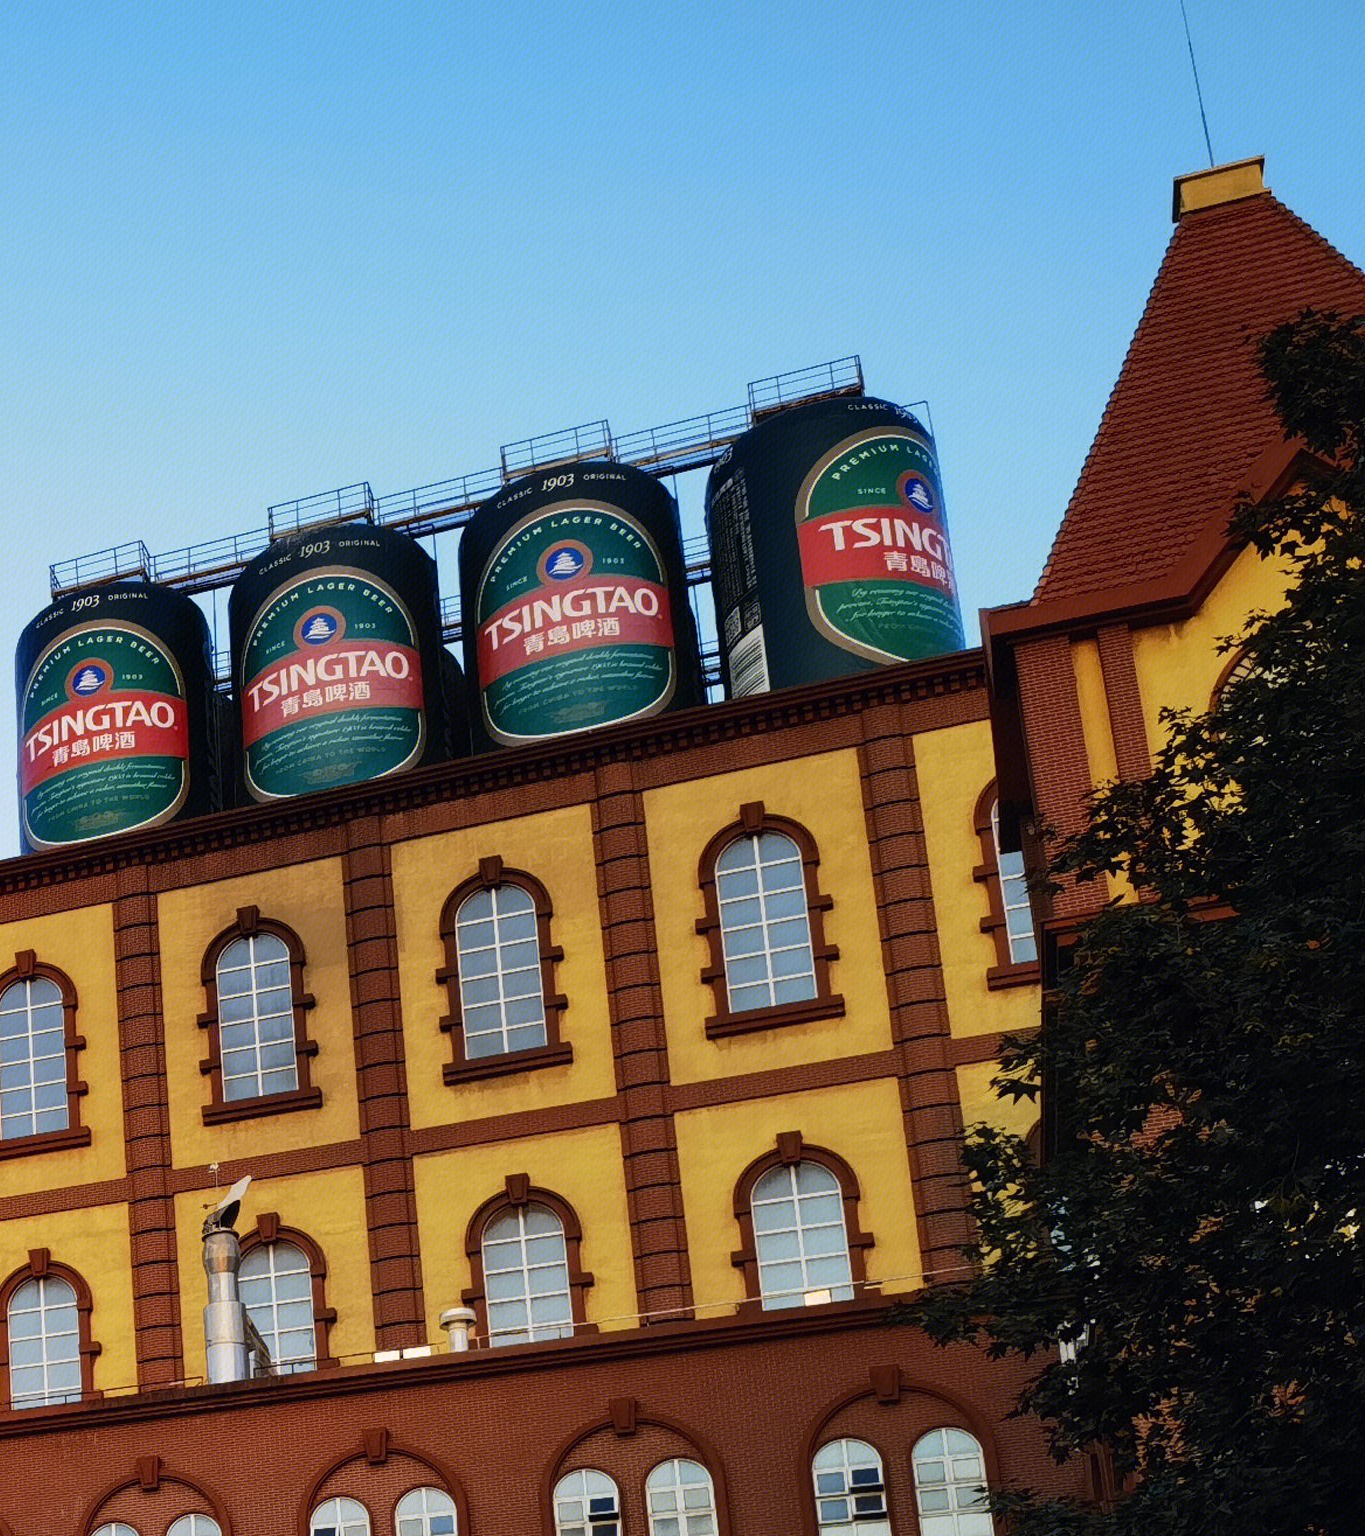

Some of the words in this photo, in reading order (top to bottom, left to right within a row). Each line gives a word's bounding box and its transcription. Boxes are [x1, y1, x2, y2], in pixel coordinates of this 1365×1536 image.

[847, 403, 889, 411] CLASSIC
[832, 444, 900, 480] PREMIUM
[496, 487, 533, 510] CLASSIC
[541, 473, 574, 492] 1903
[857, 487, 887, 495] SINCE
[258, 554, 292, 576] CLASSIC
[299, 540, 331, 559] 1903
[338, 539, 381, 548] ORIGINAL
[490, 526, 543, 583] PREMIUM
[551, 516, 603, 528] LAGER
[609, 523, 642, 549] BEER
[36, 608, 65, 629] CLASSIC
[71, 594, 100, 612] 1903
[107, 592, 148, 601] ORIGINAL
[253, 592, 300, 647] PREMIUM
[307, 582, 356, 594] LAGER
[362, 588, 394, 614] BEER
[484, 586, 659, 651] TSINGTAO
[523, 617, 621, 656] 青島啤酒
[29, 646, 71, 699] PREMIUM
[77, 635, 124, 647] LAGER
[130, 640, 160, 665] BEER
[247, 650, 410, 713] TSINGTAO
[280, 681, 370, 718] 青島啤酒
[25, 700, 175, 763] TSINGTAO
[52, 731, 136, 767] 青島啤酒
